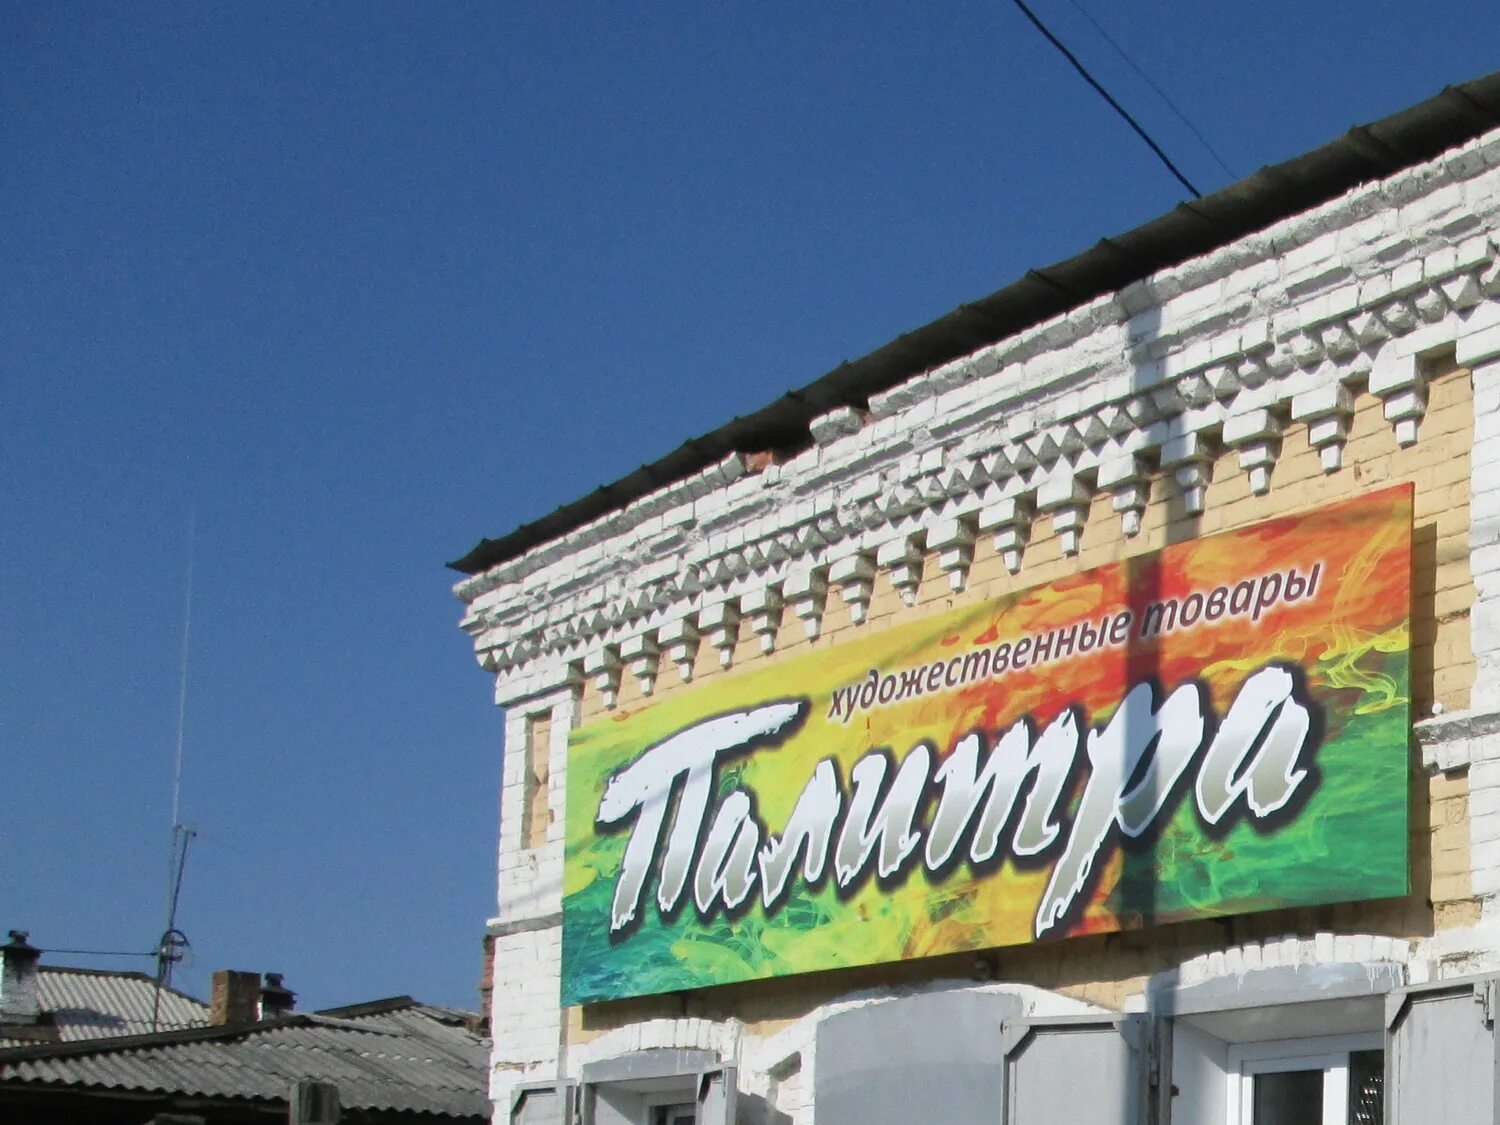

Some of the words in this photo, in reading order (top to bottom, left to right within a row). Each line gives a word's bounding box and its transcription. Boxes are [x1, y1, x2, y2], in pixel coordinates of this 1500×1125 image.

[827, 610, 1132, 722] художественные
[1140, 563, 1322, 637] товары
[597, 666, 1311, 939] Палитра
